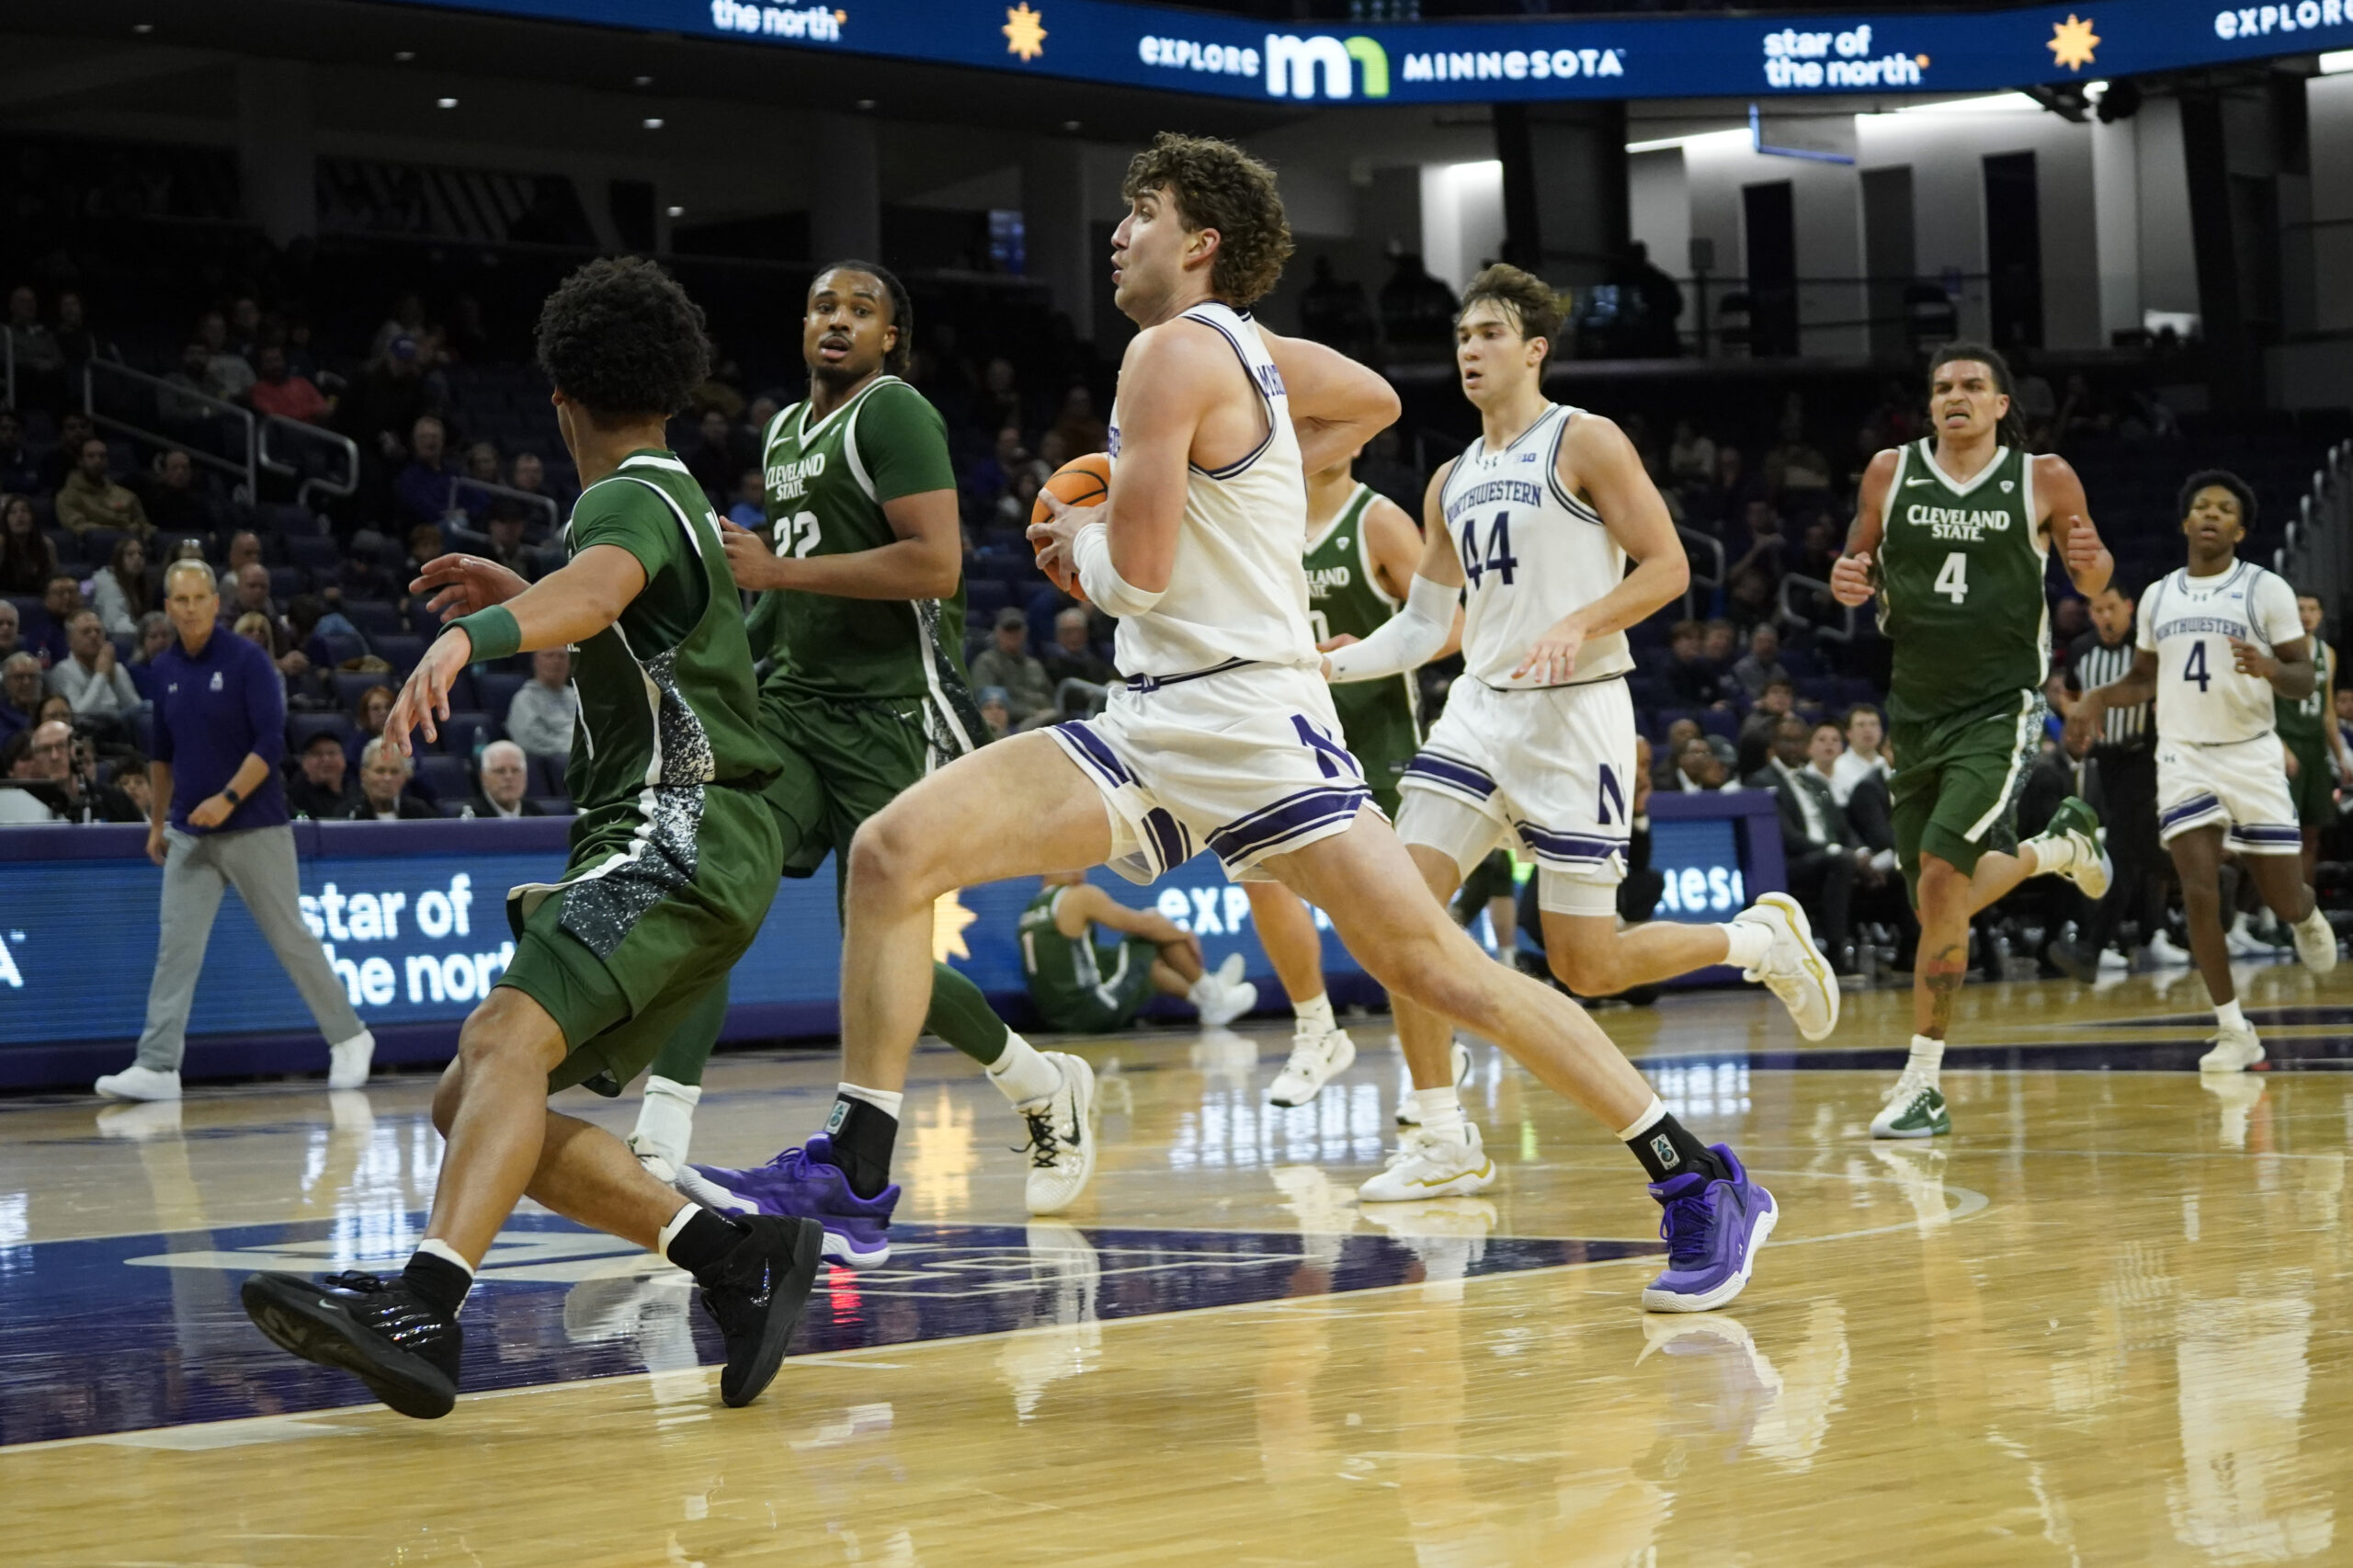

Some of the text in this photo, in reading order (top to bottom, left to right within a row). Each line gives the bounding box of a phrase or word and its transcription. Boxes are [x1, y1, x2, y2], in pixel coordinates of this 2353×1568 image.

[711, 0, 840, 42] the north
[1763, 24, 1872, 58] star of
[1763, 52, 1920, 87] the north
[766, 452, 825, 491] CLEVELAND
[776, 478, 804, 502] STATE
[1447, 479, 1541, 527] NORTHWESTERN
[1906, 505, 2010, 531] CLEVELAND
[1462, 509, 1518, 590] 44
[1931, 524, 1981, 540] STATE
[1934, 552, 1969, 604] 4
[2184, 640, 2211, 692] 4
[299, 873, 472, 941] star of
[323, 944, 395, 1006] he
